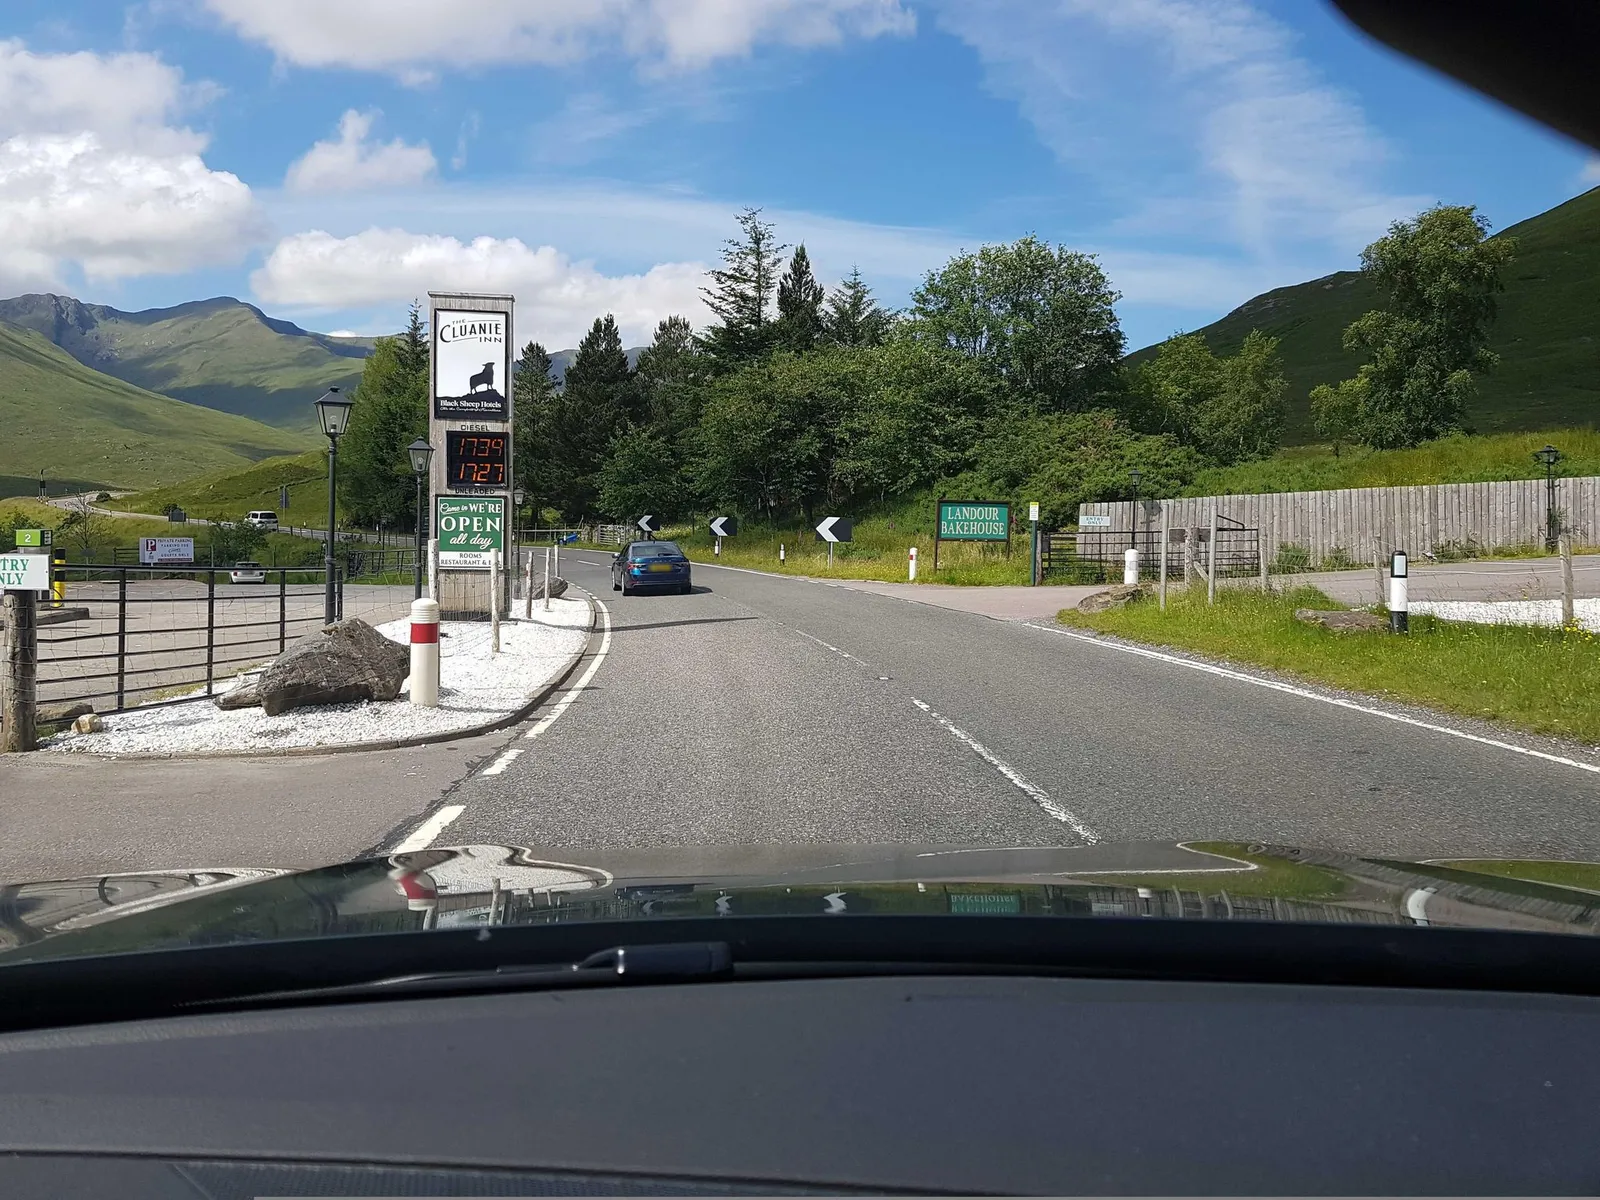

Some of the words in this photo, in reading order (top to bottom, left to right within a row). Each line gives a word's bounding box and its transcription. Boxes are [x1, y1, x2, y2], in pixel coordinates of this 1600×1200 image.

[440, 323, 502, 343] CLUANIE
[460, 400, 480, 408] Sheep
[459, 438, 504, 457] 1739
[459, 463, 504, 482] 1727
[440, 503, 460, 515] Come
[469, 502, 502, 513] WE'RE
[948, 507, 999, 520] LANDOUR
[440, 516, 501, 532] OPEN
[941, 521, 1005, 535] BAKEHOUSE
[24, 533, 31, 543] 2
[450, 533, 468, 544] all
[470, 533, 493, 549] day
[147, 540, 156, 551] P
